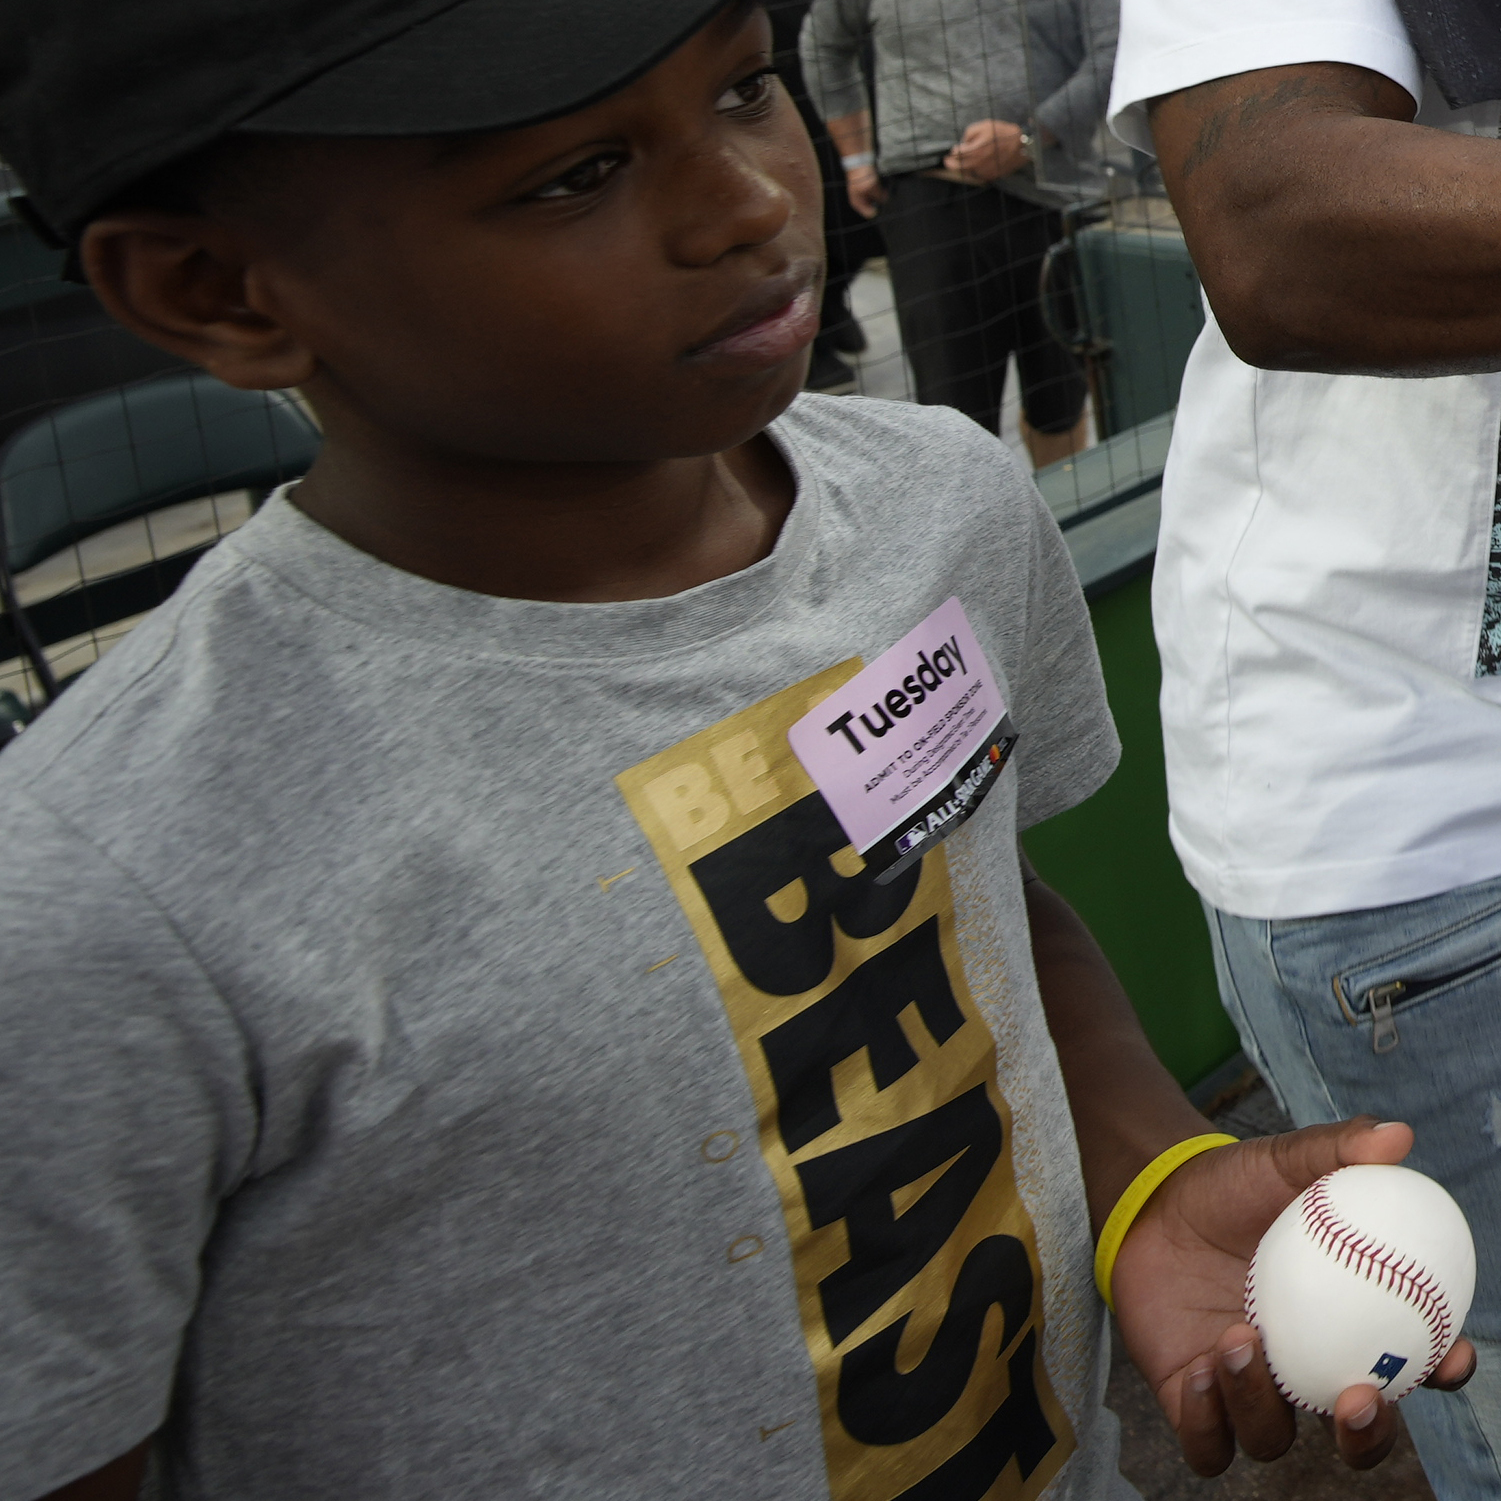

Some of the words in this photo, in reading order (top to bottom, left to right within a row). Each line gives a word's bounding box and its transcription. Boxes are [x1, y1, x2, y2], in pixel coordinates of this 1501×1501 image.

[825, 635, 968, 755] Tuesday
[642, 729, 781, 852] BE
[863, 761, 898, 795] ADMIT
[897, 749, 914, 765] TO
[686, 788, 1058, 1501] BEAST
